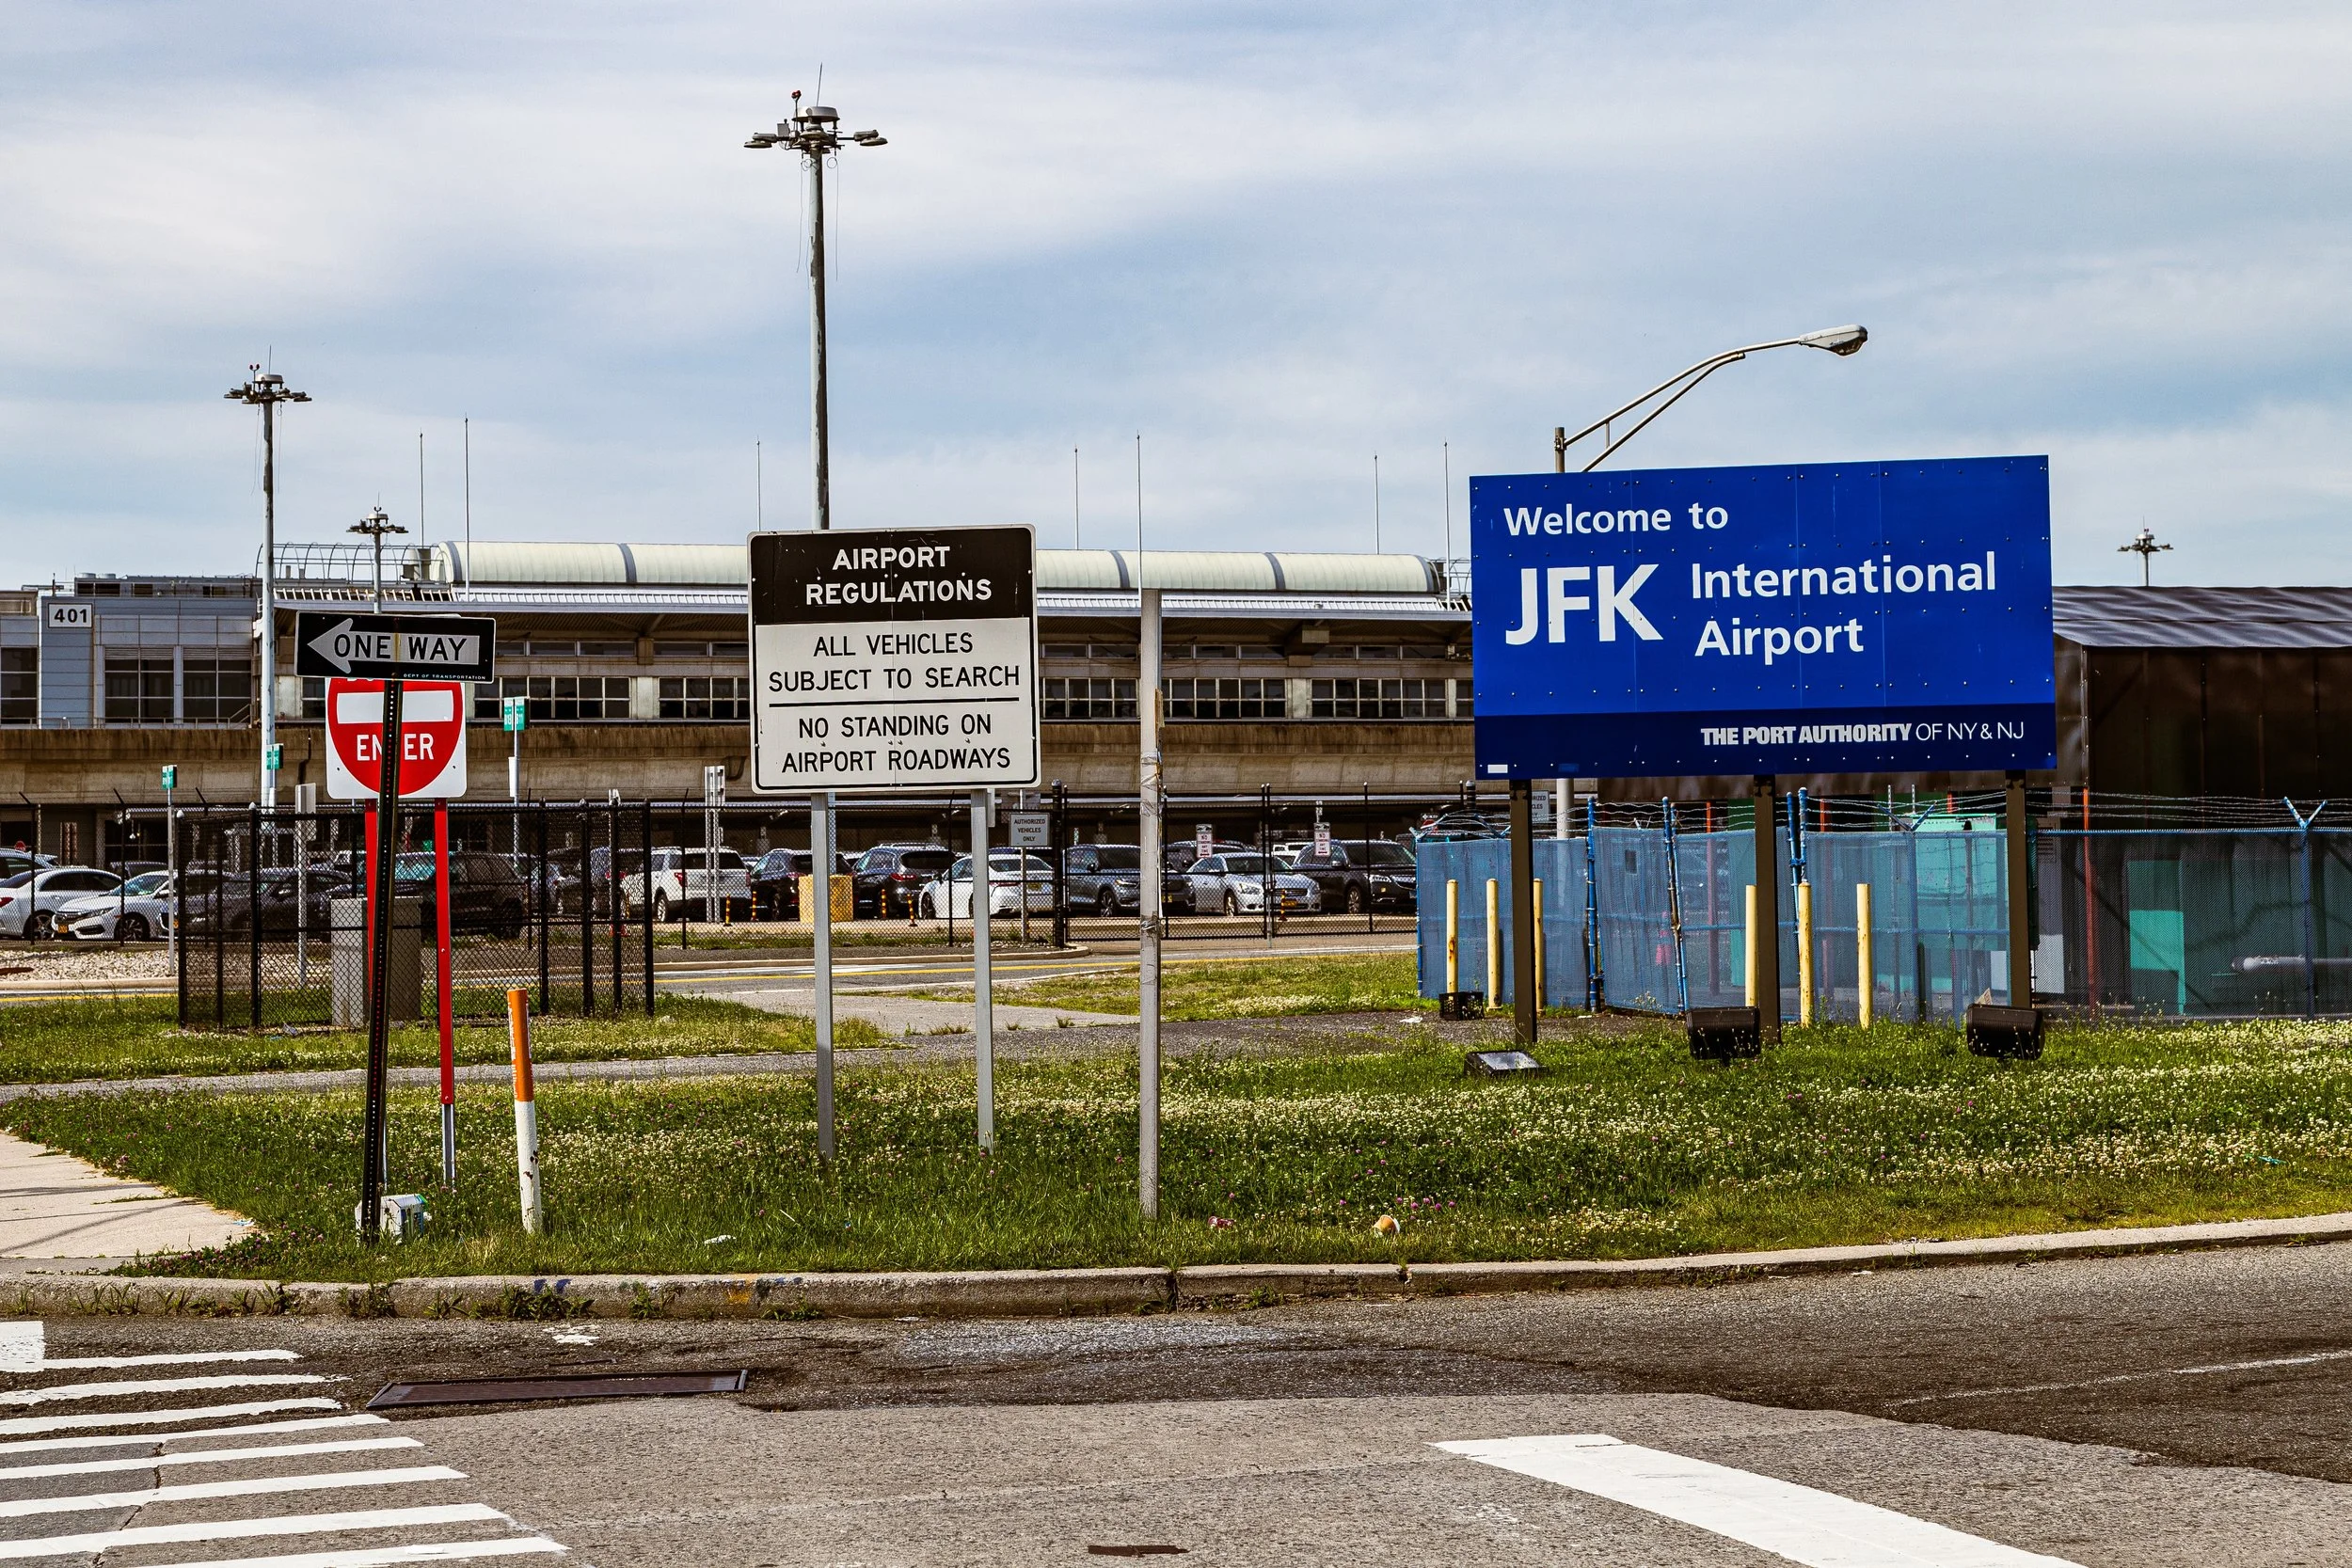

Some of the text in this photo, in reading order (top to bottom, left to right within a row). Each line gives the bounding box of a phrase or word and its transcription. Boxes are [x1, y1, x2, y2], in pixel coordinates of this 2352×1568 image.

[1503, 502, 1728, 536] Welcome to
[832, 546, 950, 570] AIRPORT
[1692, 551, 1995, 598] International
[806, 578, 992, 605] REGULATIONS
[1505, 564, 1663, 645] JFK
[54, 608, 87, 623] 401
[334, 634, 468, 661] ONE WAY
[813, 632, 974, 657] ALL VEHICLES
[1694, 618, 1864, 665] Airport
[769, 665, 1020, 692] SUBJECT TO SEARCH
[799, 713, 992, 739] NO STANDING ON
[1701, 721, 2024, 745] THE PORT AUTHORITY OF NY & NJ
[357, 733, 434, 761] ENER
[782, 747, 1011, 773] AIRPORT ROADWAYS
